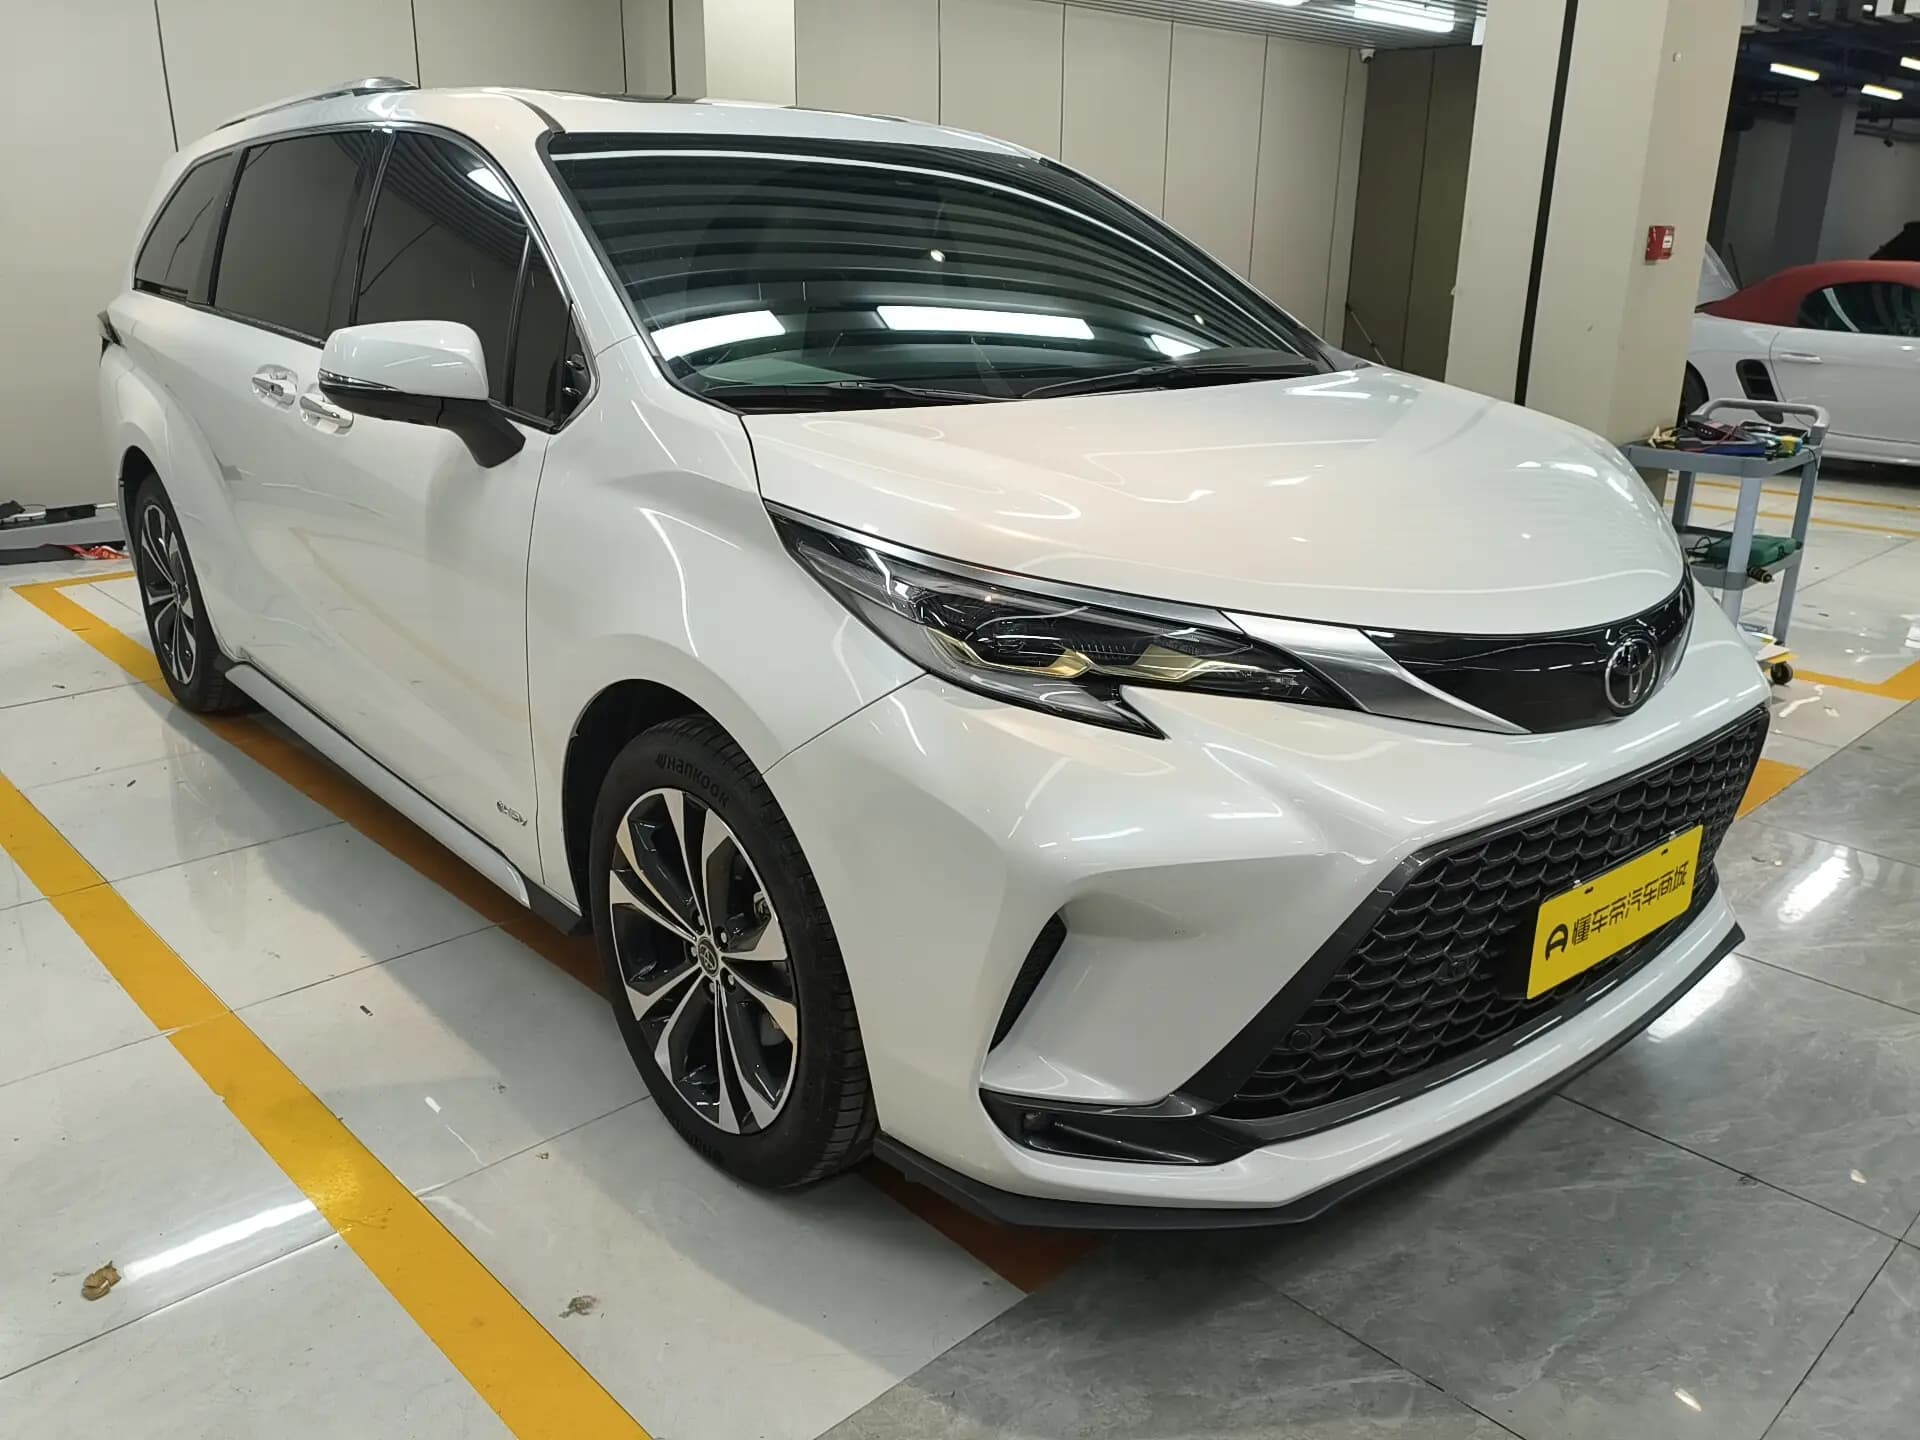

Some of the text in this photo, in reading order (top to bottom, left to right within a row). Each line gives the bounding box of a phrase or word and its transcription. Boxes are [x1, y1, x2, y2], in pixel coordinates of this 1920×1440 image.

[1571, 860, 1689, 946] 懂车帝汽车商城
